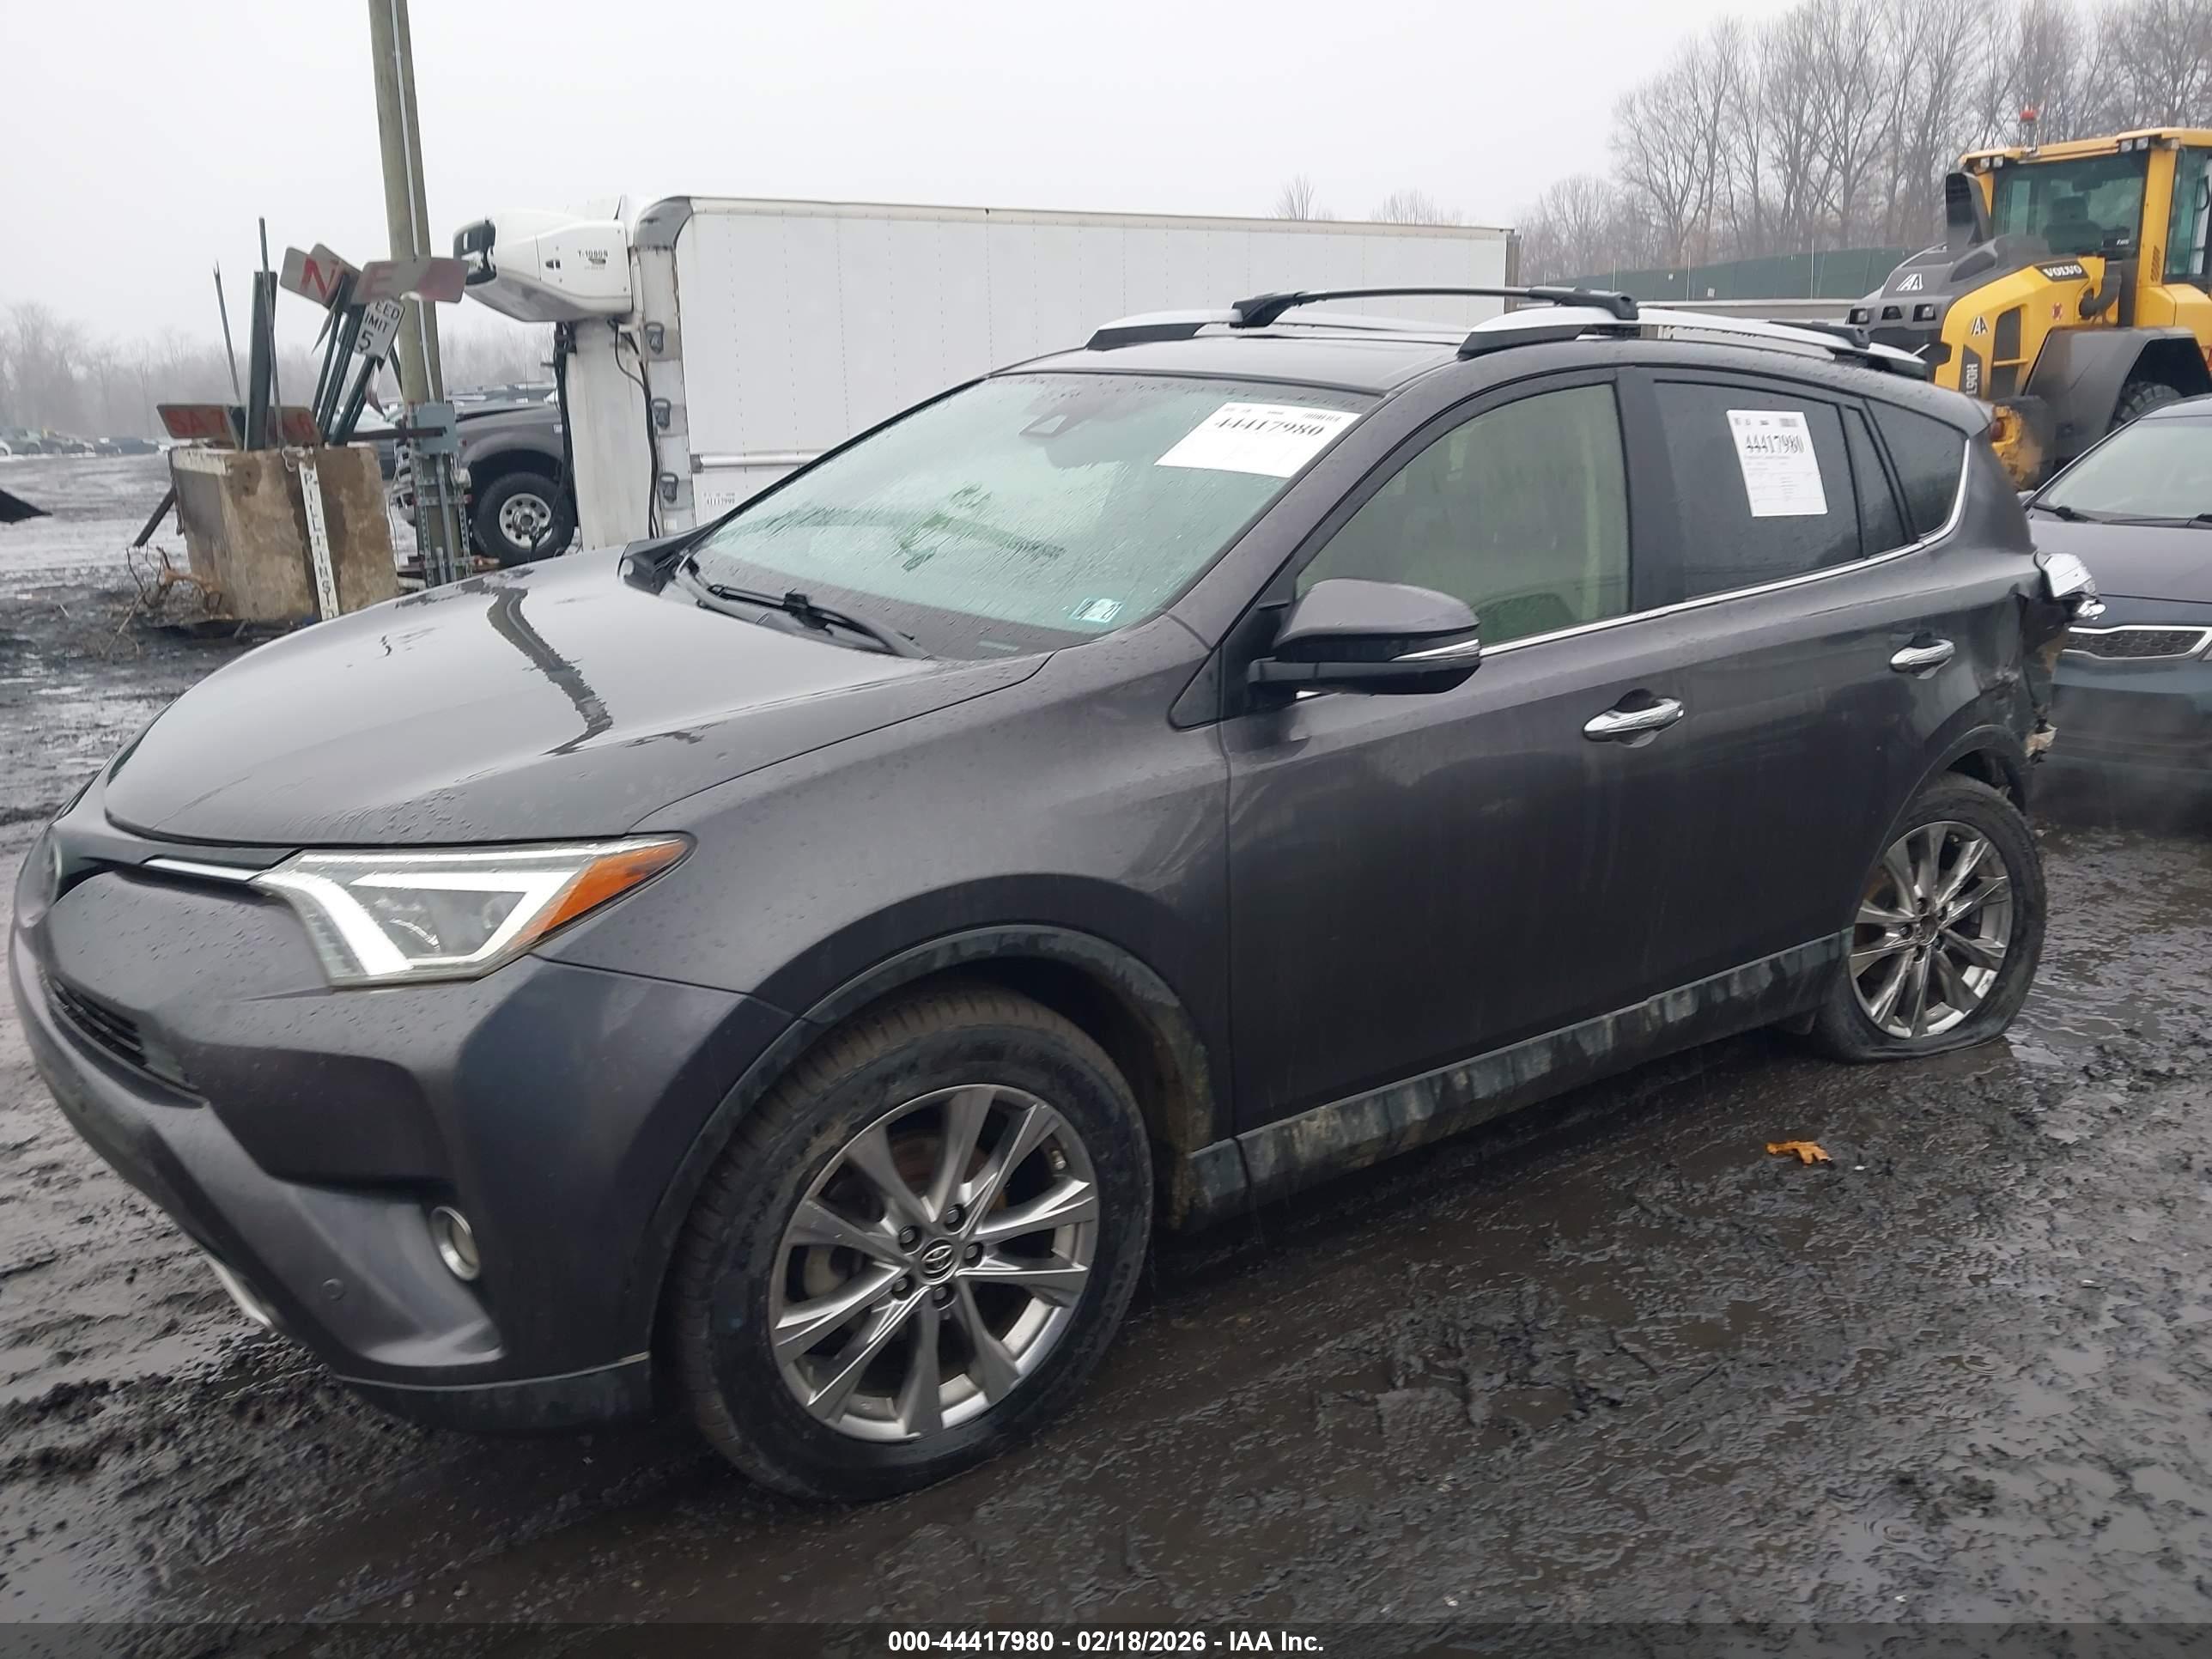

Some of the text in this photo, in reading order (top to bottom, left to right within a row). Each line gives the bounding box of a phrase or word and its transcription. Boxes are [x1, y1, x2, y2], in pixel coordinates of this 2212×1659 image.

[2042, 264, 2082, 277] VOLVO
[375, 301, 400, 321] EED
[363, 312, 389, 334] IMIT
[1213, 417, 1325, 436] 44417980
[1747, 434, 1805, 454] 44417980
